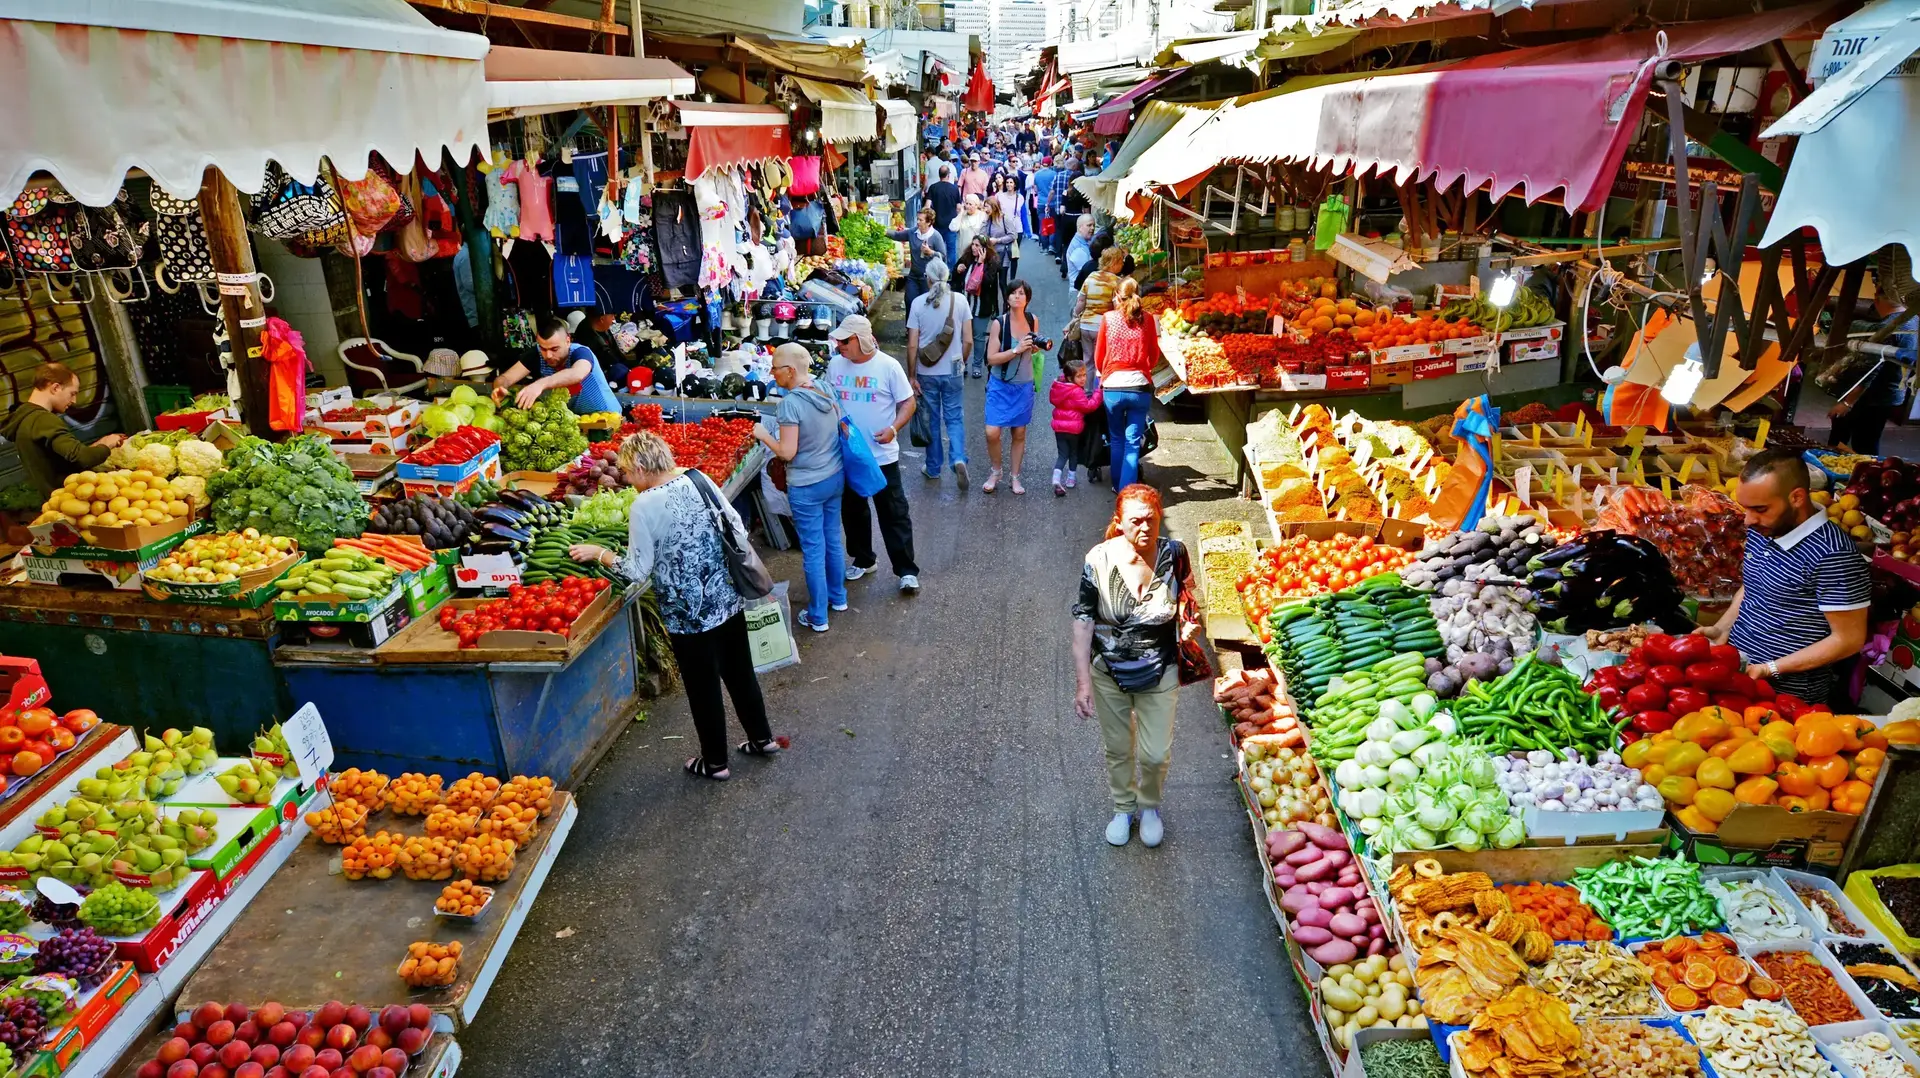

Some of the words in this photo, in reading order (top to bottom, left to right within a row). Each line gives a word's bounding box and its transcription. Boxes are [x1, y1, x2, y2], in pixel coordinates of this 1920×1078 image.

[1832, 37, 1868, 56] זוהר
[25, 557, 68, 572] מובחרים
[28, 570, 55, 582] פירות
[491, 574, 518, 582] ברעם
[154, 896, 214, 968] בראשית
